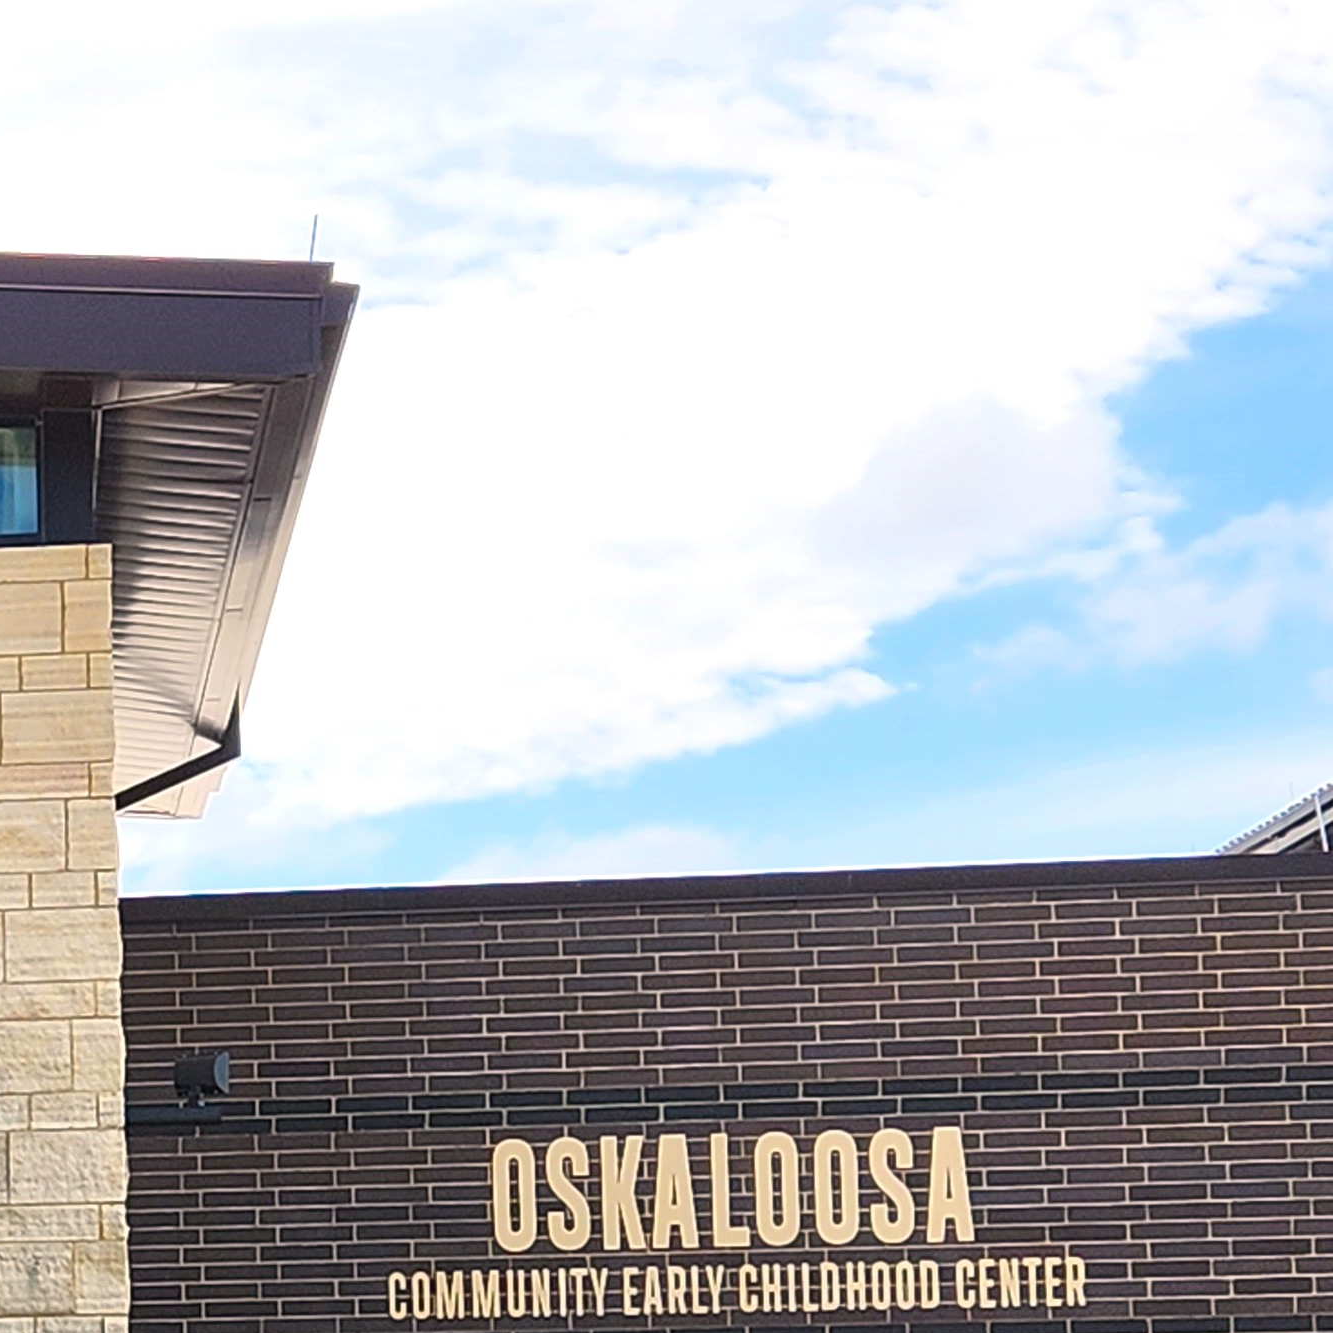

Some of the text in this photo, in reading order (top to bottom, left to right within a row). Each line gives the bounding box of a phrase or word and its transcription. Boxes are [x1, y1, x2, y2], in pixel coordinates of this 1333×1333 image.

[491, 1125, 977, 1252] OSKALOOSA
[388, 1256, 1088, 1320] COMMUNITY EARLY CHILDHOOD CENTER
